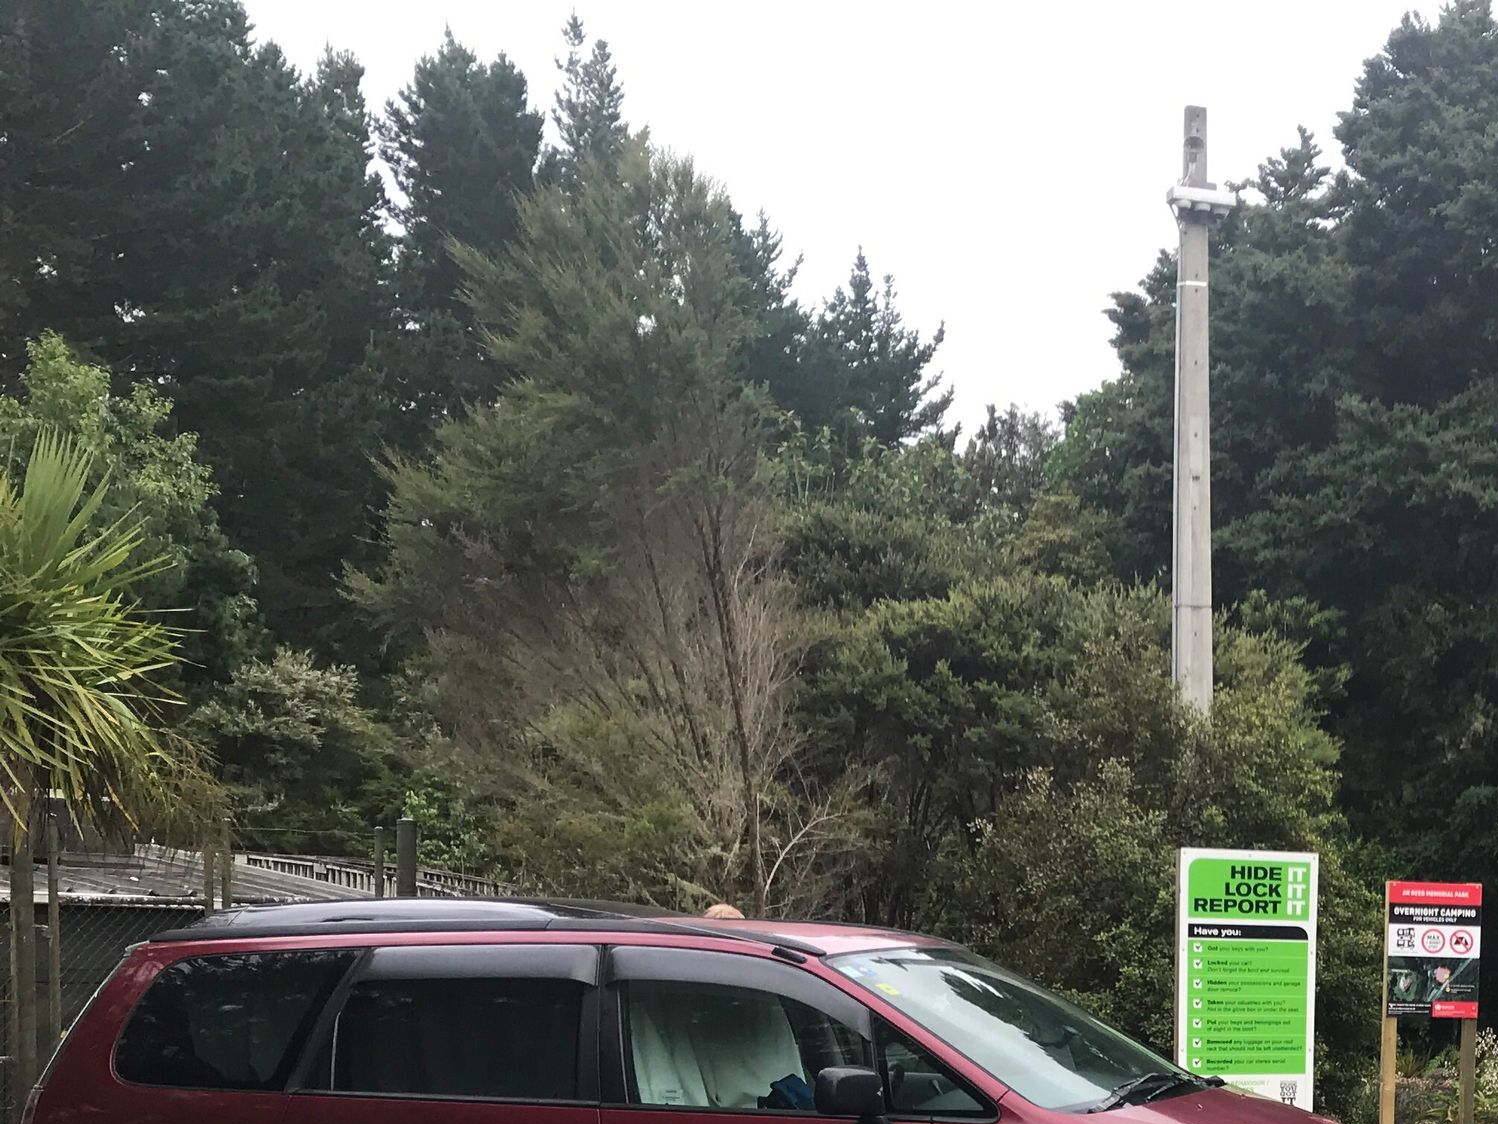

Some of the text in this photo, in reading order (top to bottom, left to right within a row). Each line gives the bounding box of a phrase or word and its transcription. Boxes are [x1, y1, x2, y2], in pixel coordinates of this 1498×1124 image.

[1231, 865, 1307, 882] HIDE IT
[1225, 882, 1306, 899] LOCK IT
[1426, 890, 1454, 898] MEMORIAL
[1194, 898, 1305, 916] REPORT IT
[1393, 906, 1477, 918] OVERNIGHT CAMPING
[1193, 926, 1242, 938] Have you:
